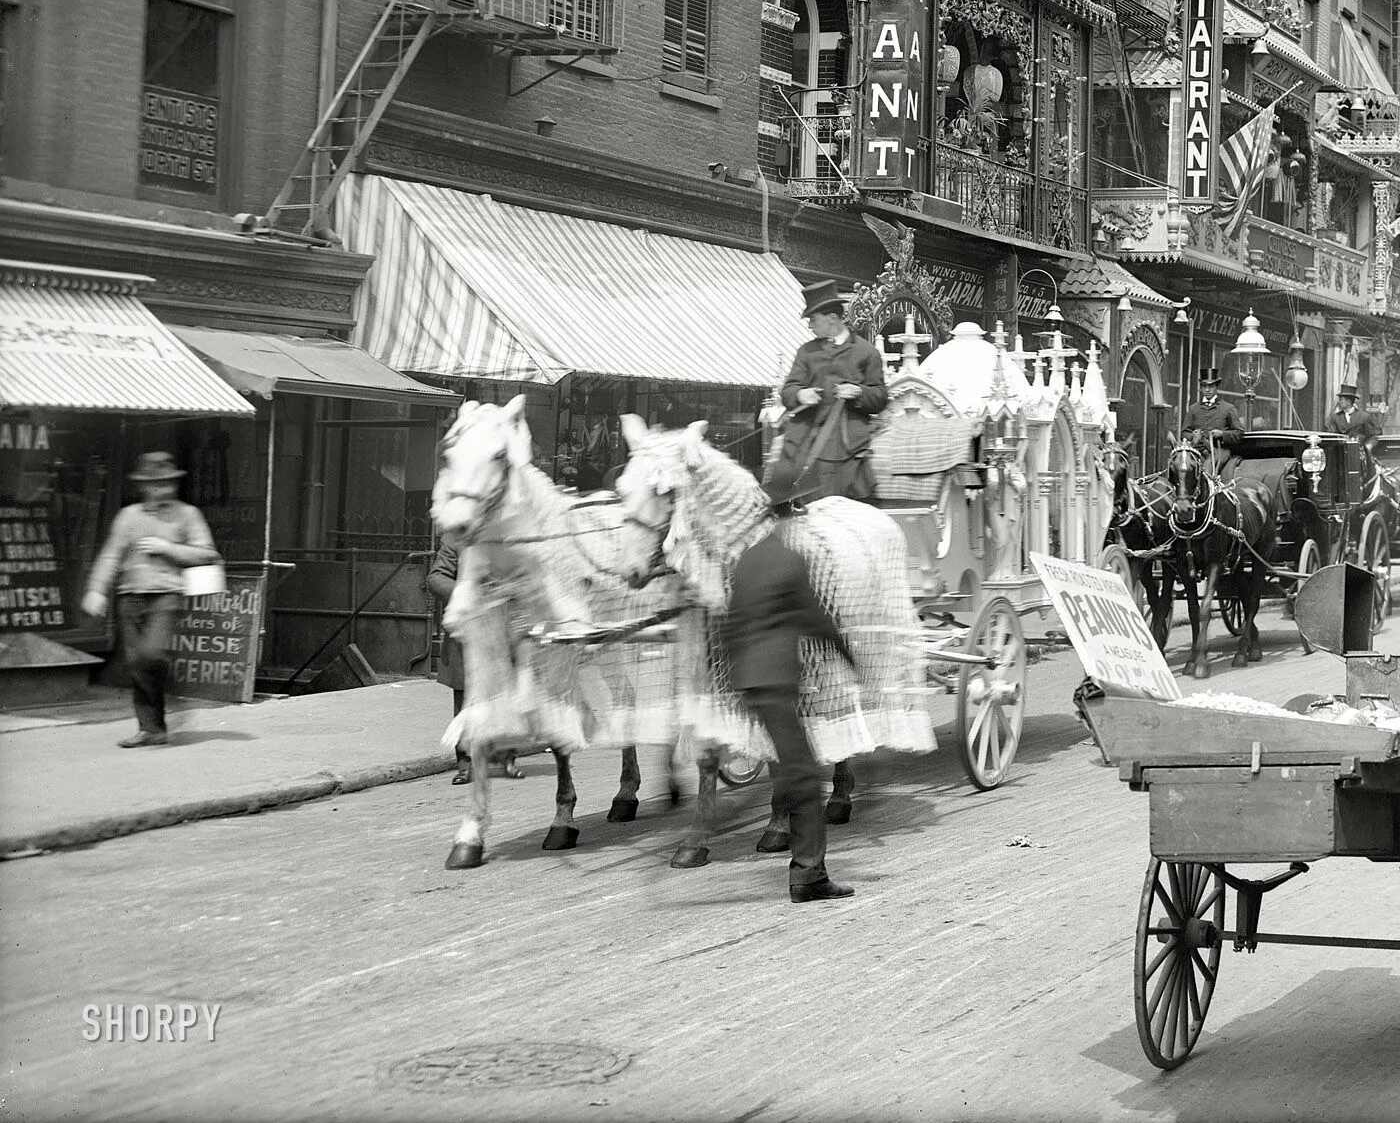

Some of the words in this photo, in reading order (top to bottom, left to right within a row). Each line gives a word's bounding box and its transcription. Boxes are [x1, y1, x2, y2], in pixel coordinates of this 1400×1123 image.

[143, 91, 218, 130] ENTISTS
[932, 264, 956, 279] WING
[959, 271, 984, 284] TONG
[1208, 313, 1241, 336] KEE
[1060, 590, 1153, 652] PEANUTS
[170, 635, 242, 655] INESE
